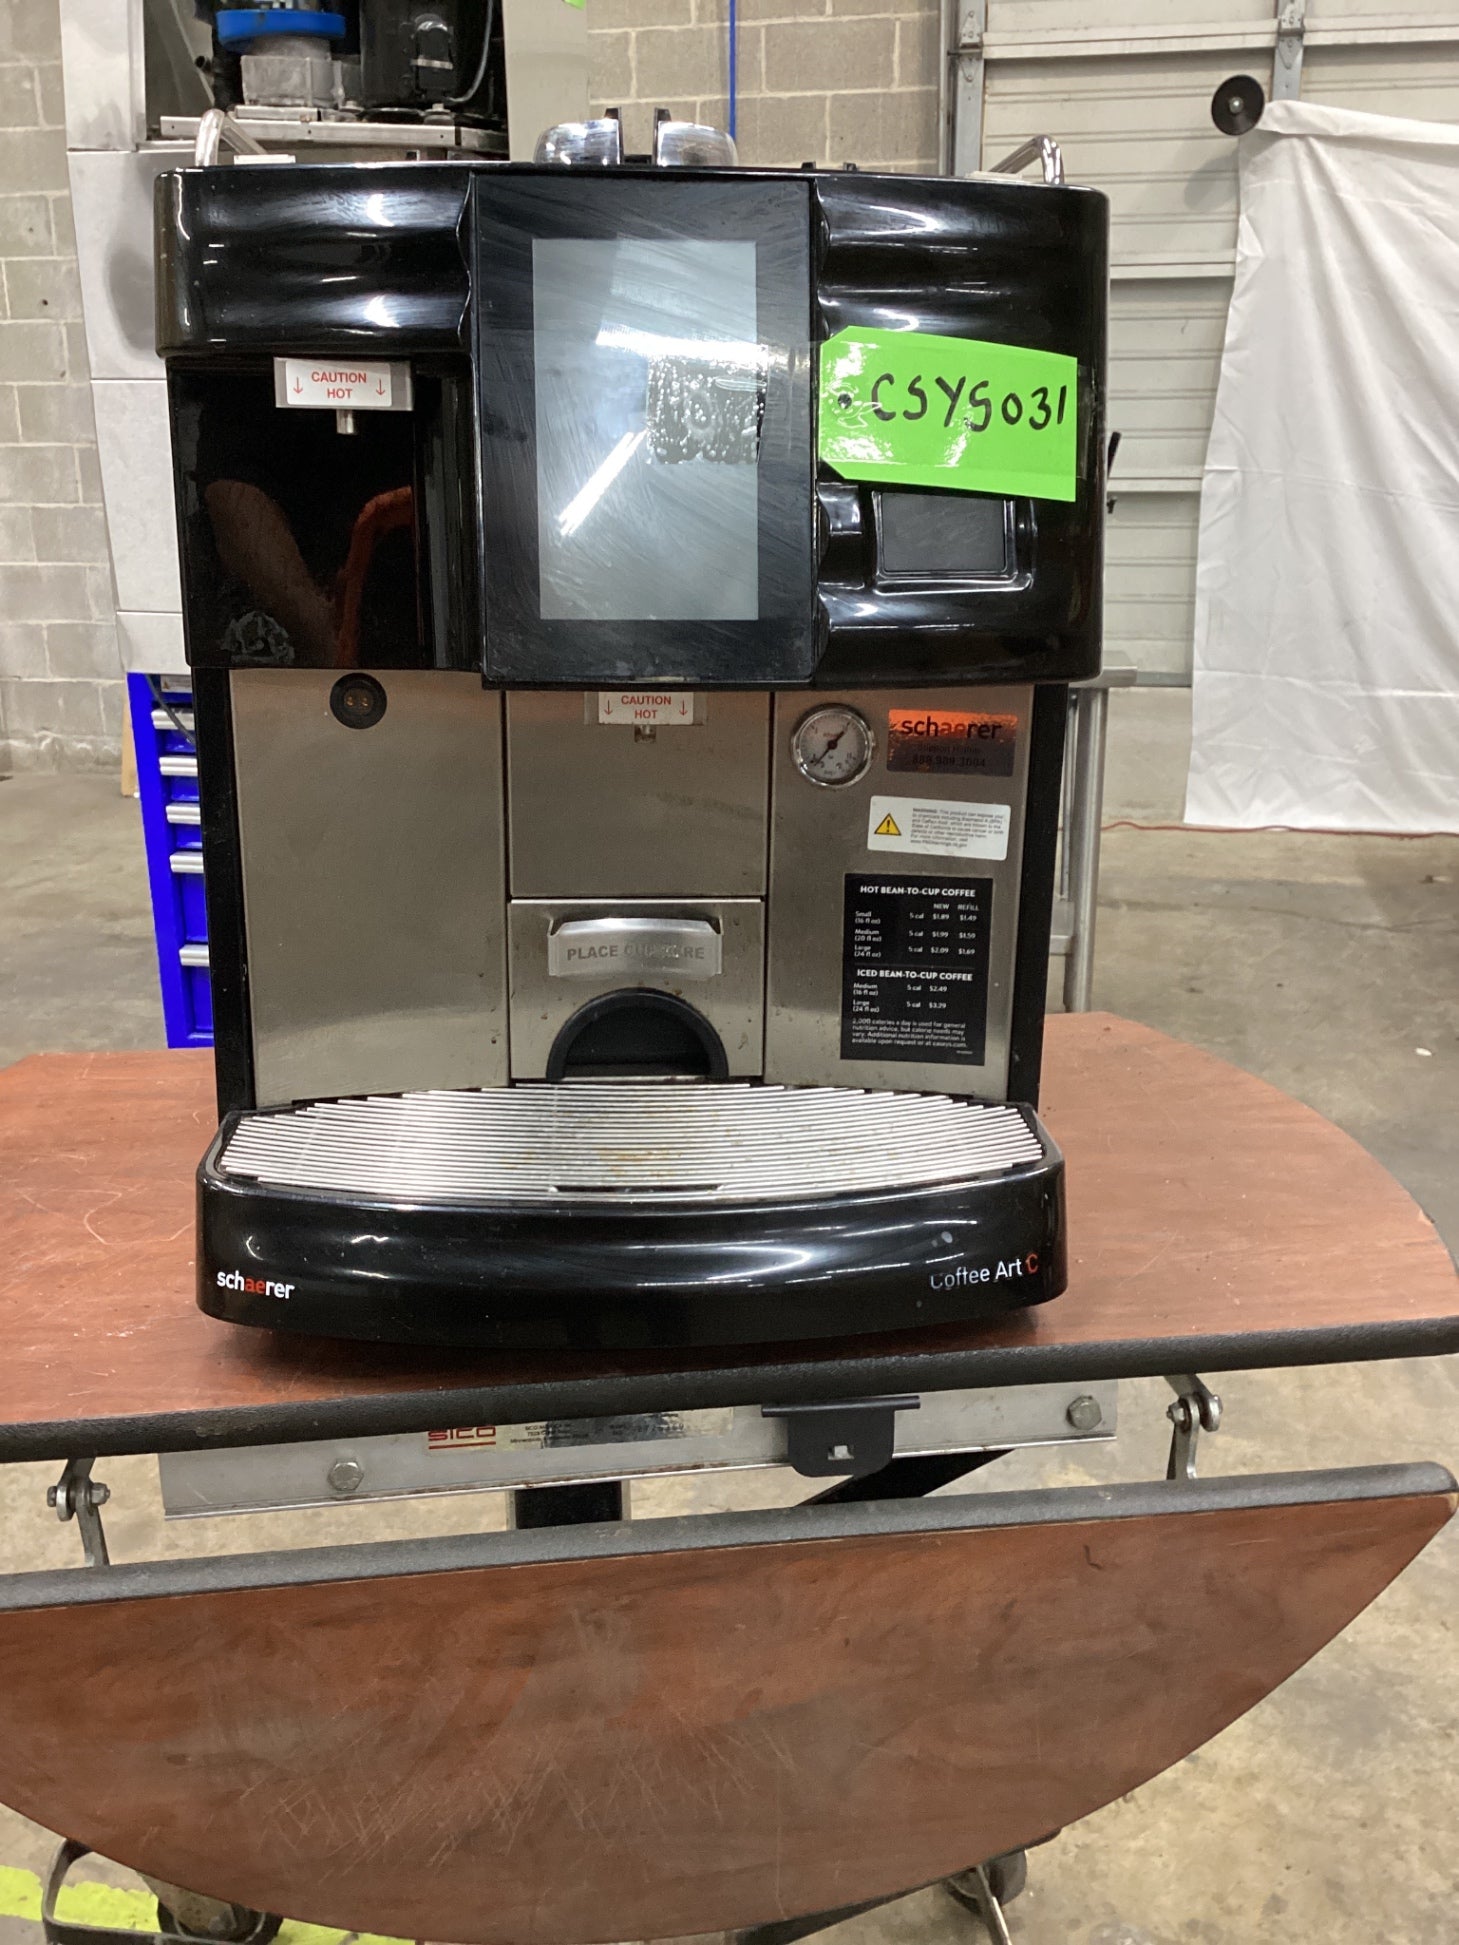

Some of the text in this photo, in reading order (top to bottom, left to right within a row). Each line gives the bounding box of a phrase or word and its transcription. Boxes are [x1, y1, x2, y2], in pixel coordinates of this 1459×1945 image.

[311, 371, 367, 383] CAUTION
[327, 388, 353, 399] HOT
[621, 695, 672, 706] CAUTION
[634, 709, 658, 719] HOT
[901, 716, 1003, 739] schaerer
[881, 887, 940, 895] BEAN-TO-CUP
[942, 889, 976, 897] COFFEE
[567, 945, 618, 961] PLACE
[857, 969, 973, 981] ICED BEAN-TO-CUP COFFEE
[930, 1253, 1039, 1290] Coffee Art C
[216, 1269, 296, 1299] schaerer
